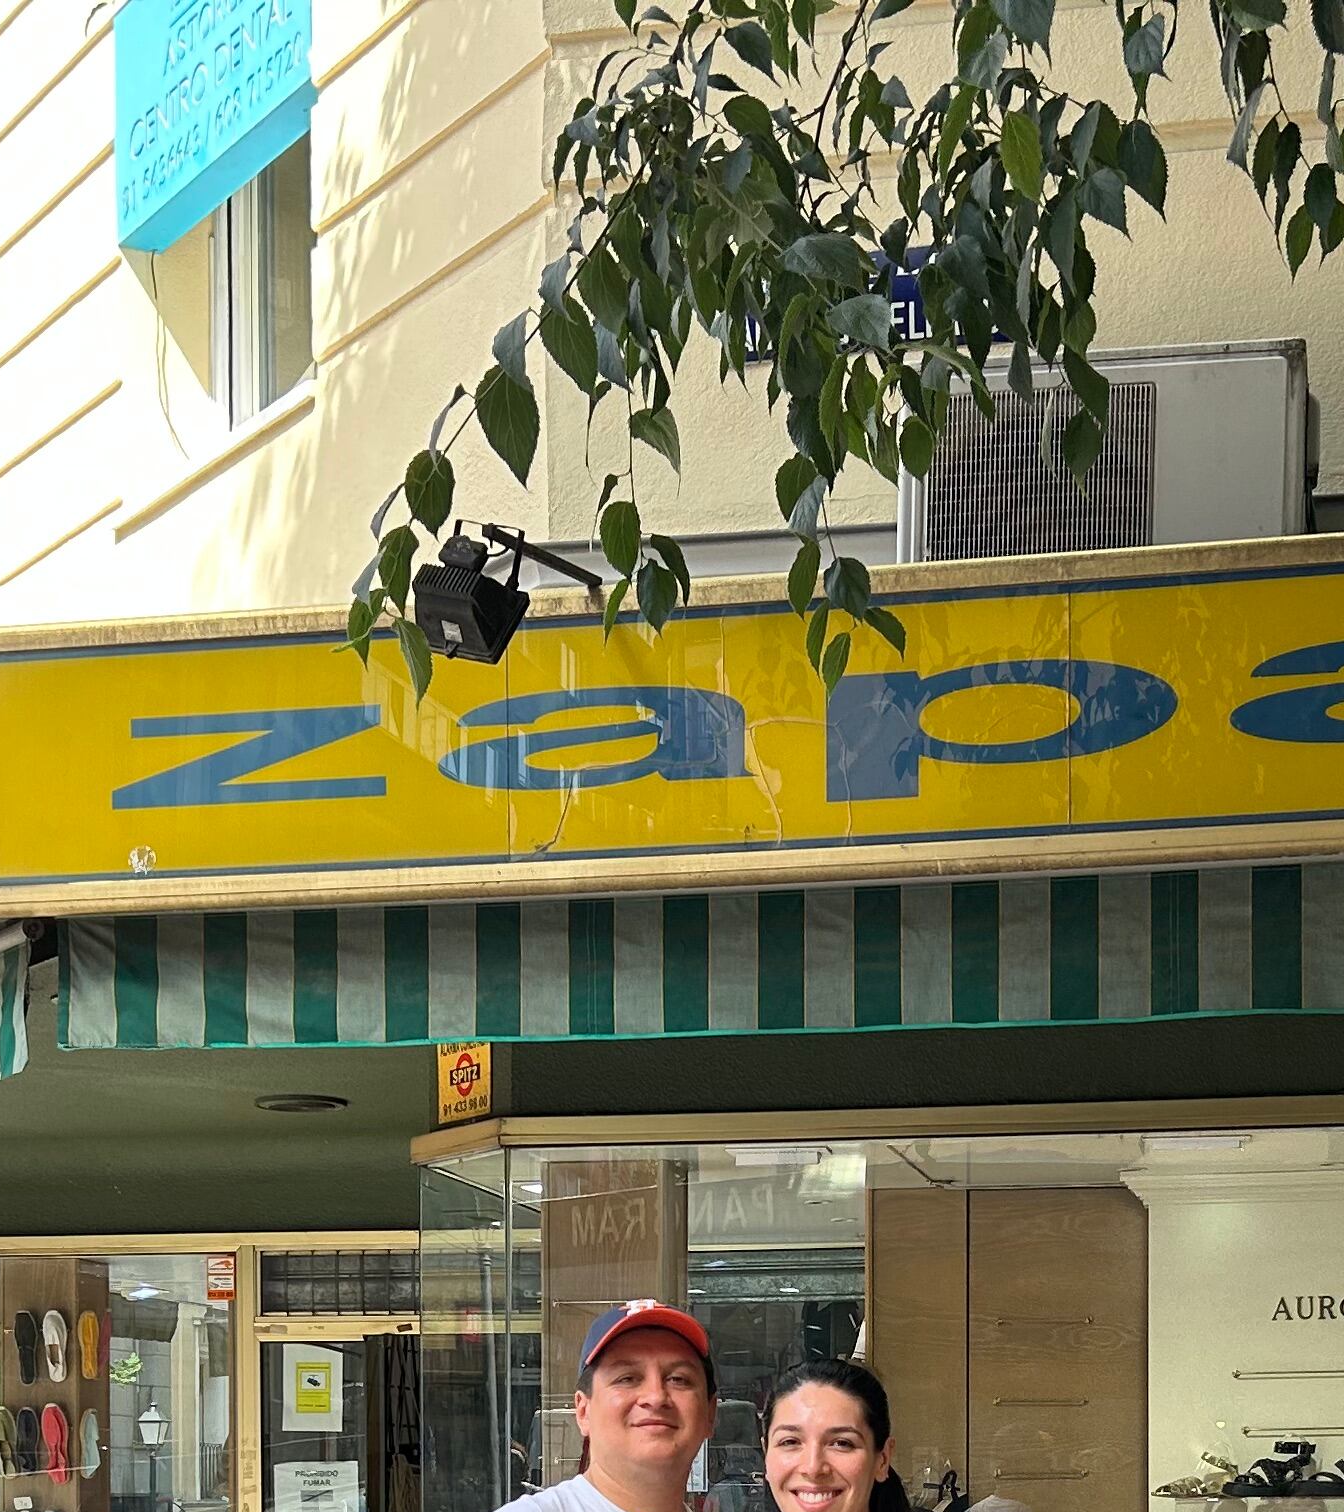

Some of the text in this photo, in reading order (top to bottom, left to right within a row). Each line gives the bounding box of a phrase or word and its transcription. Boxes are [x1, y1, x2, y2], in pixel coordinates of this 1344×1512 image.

[130, 0, 293, 160] CENTRO DENTAL
[451, 1065, 479, 1085] SPITZ
